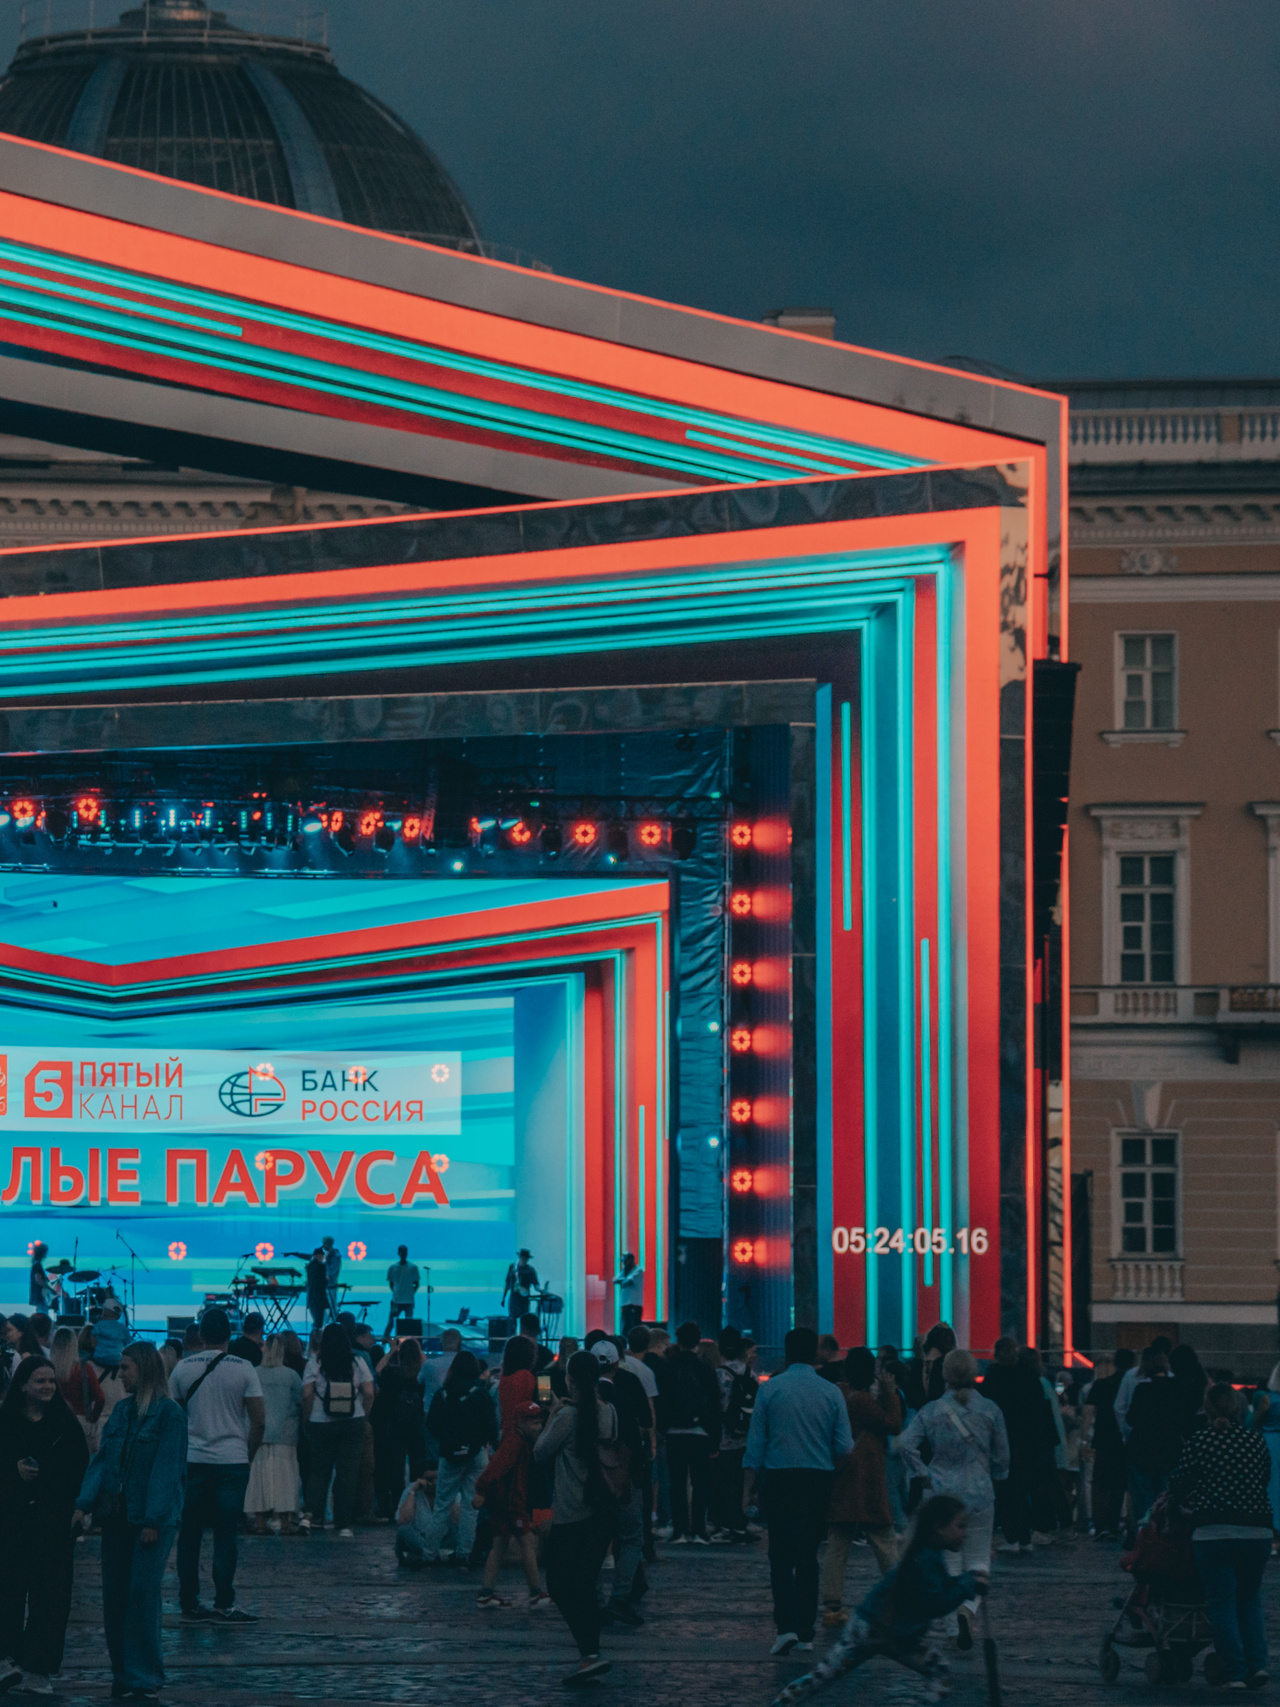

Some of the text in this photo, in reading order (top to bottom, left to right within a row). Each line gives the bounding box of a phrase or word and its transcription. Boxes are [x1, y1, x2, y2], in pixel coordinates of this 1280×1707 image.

[79, 1056, 183, 1087] ПЯТЫЙ
[301, 1070, 379, 1092] БАНК
[31, 1068, 66, 1113] 5
[79, 1093, 183, 1120] КАНАЛ
[301, 1100, 424, 1122] РОССИЯ
[166, 1149, 450, 1206] ПАРУСА
[831, 1226, 989, 1255] 05:24:05.16
